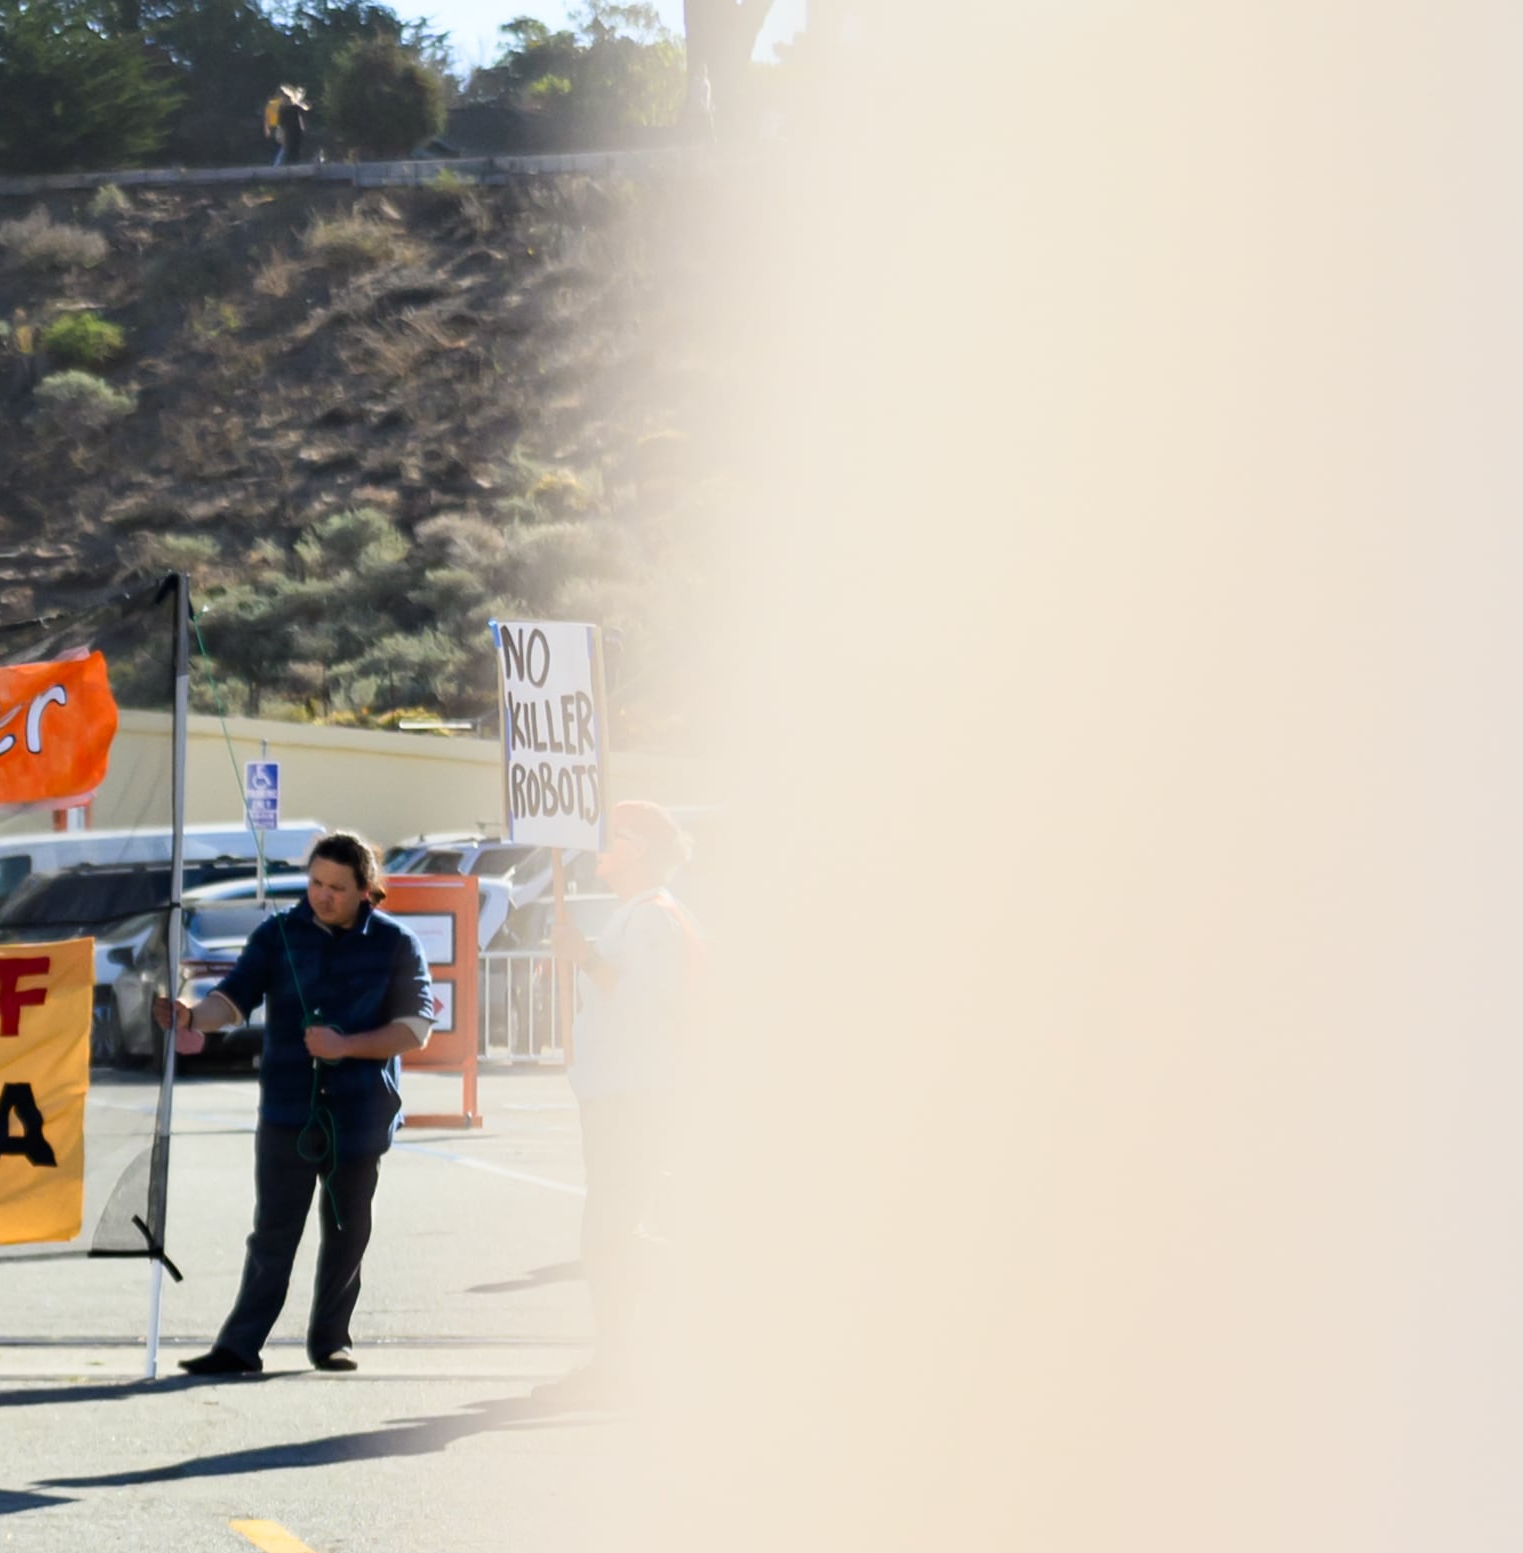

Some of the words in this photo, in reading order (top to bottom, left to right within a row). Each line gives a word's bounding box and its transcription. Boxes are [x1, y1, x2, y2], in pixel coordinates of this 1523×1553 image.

[500, 625, 551, 688] NO
[508, 690, 595, 755] KILLER
[511, 762, 600, 827] ROBOTS
